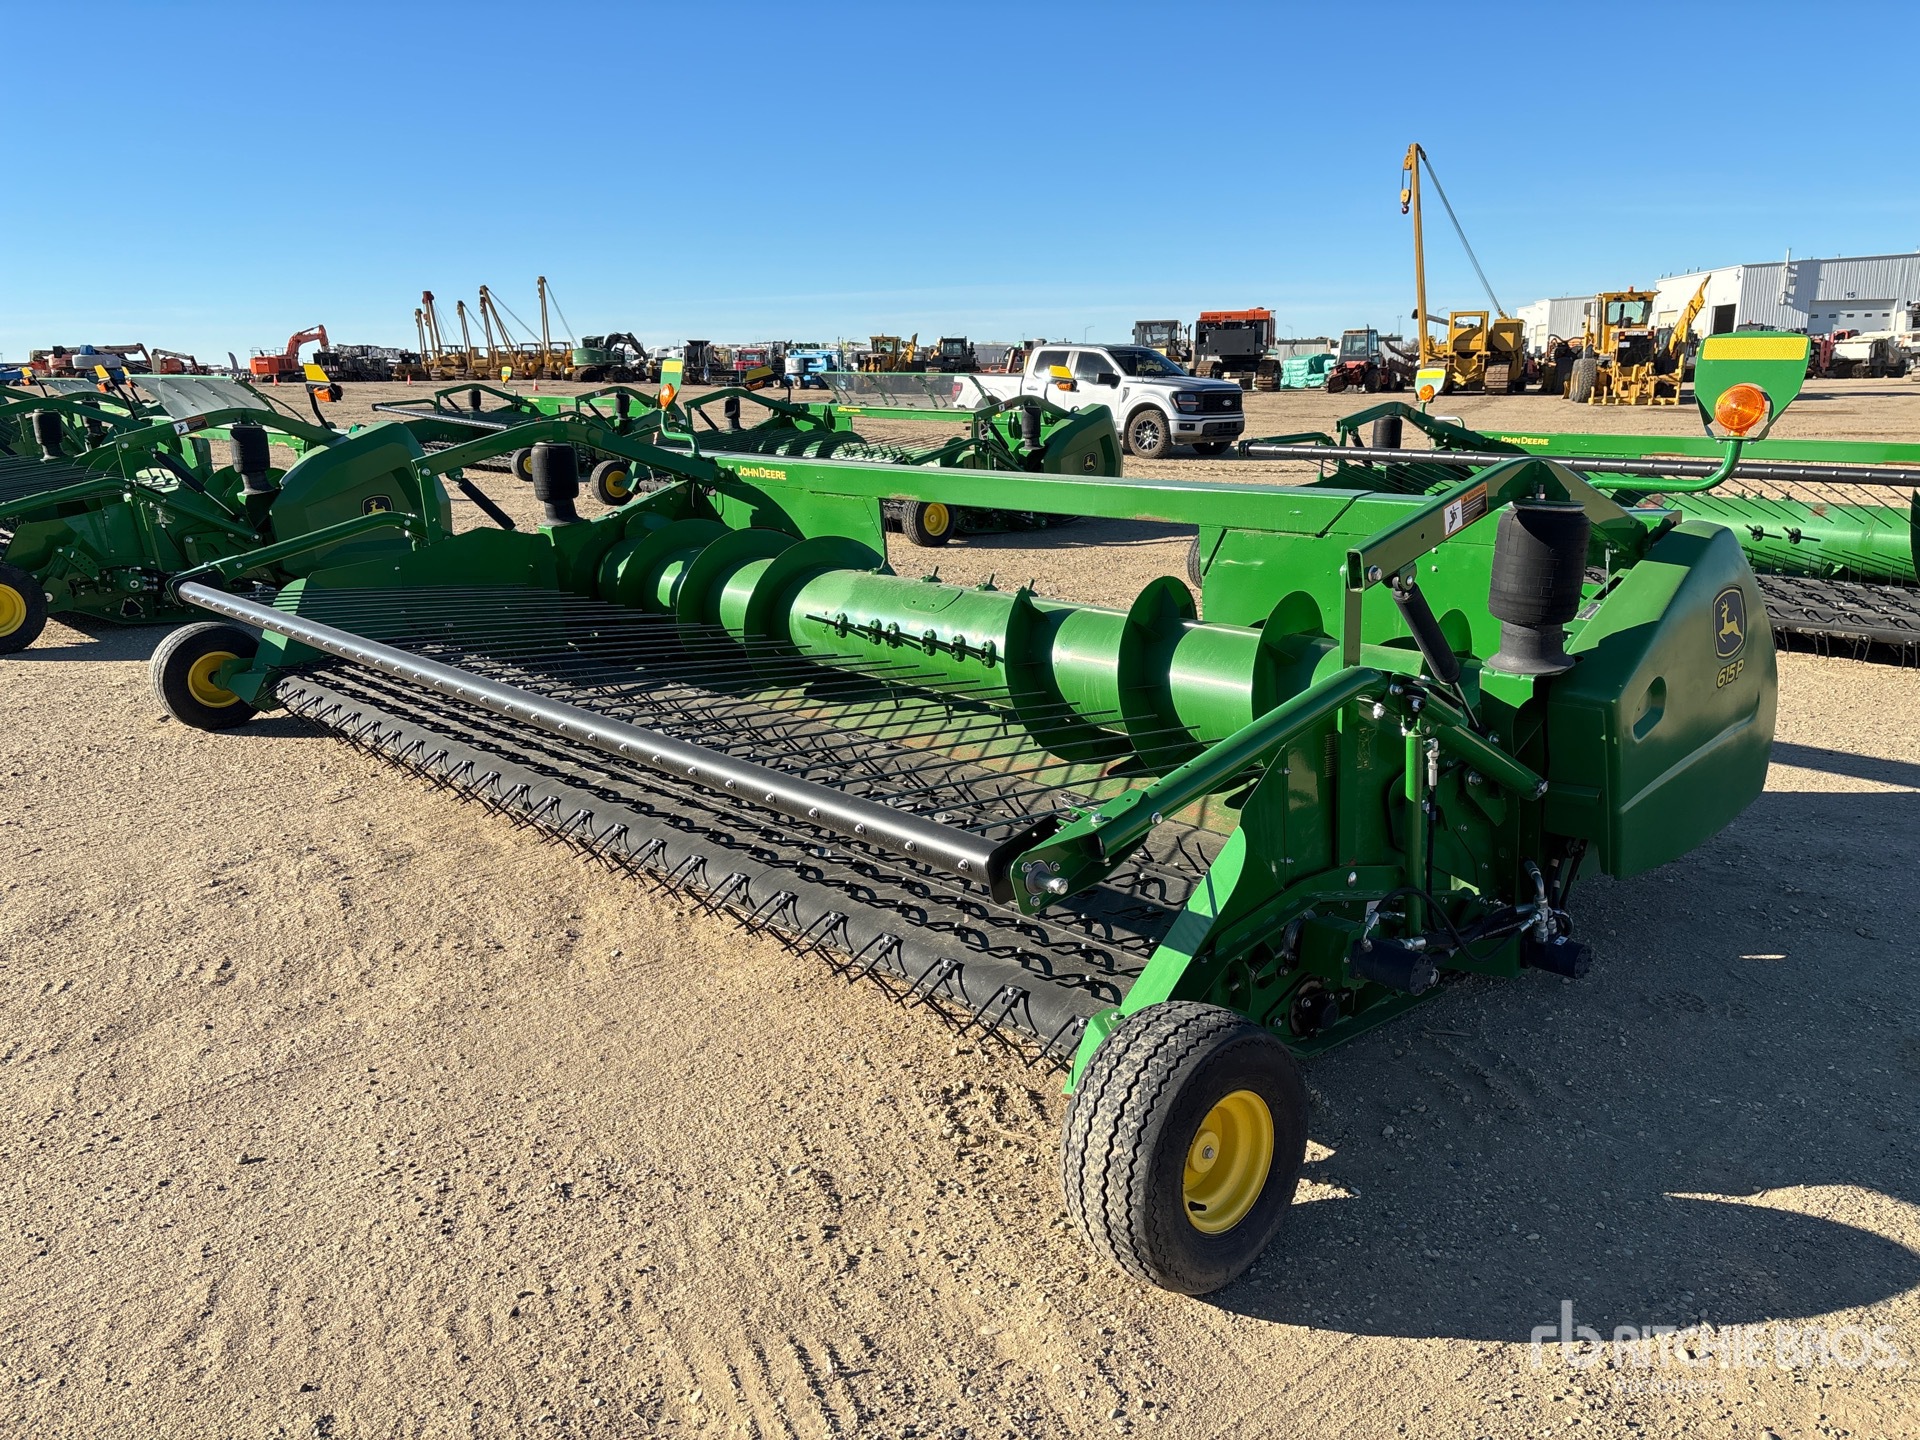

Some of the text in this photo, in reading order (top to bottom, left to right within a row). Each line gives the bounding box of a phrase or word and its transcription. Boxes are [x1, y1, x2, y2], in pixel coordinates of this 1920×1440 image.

[1846, 291, 1856, 299] 15
[1500, 436, 1550, 446] JOHN DEERE
[738, 465, 787, 480] JOHN DEERE
[1716, 659, 1745, 688] 615P
